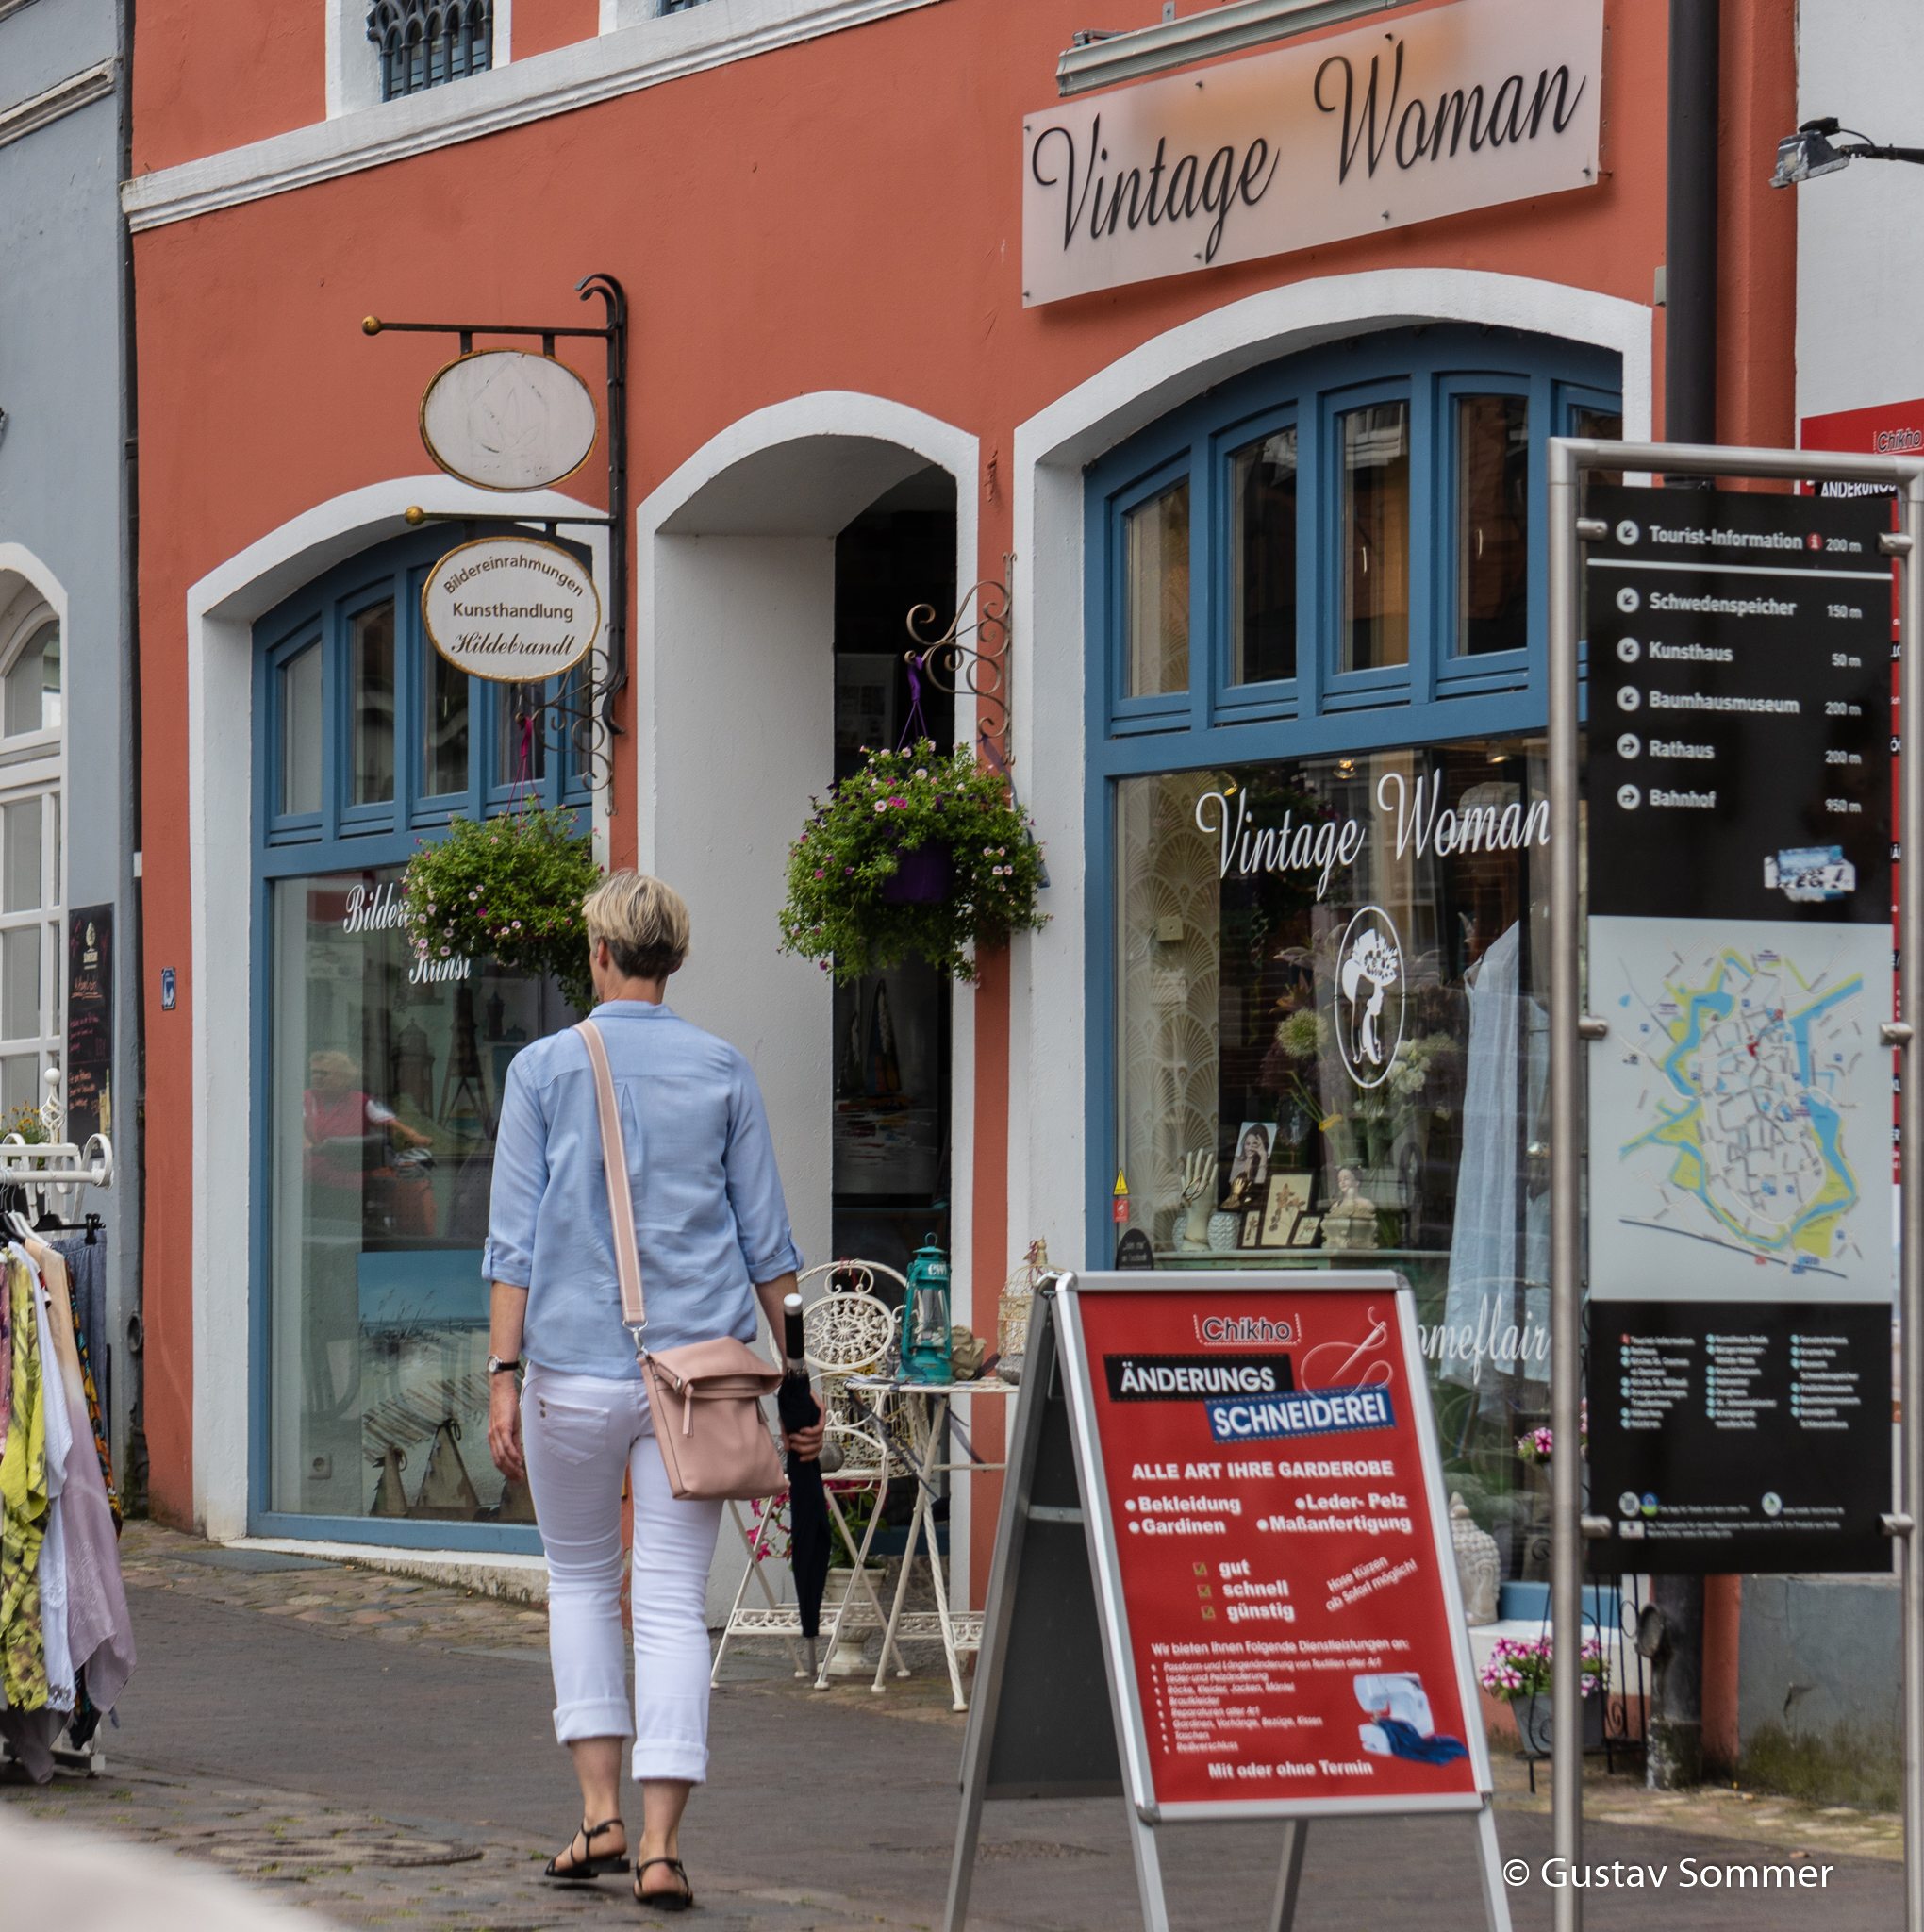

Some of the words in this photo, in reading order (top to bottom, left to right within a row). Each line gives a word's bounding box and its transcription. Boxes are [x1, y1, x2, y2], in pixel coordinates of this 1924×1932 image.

[1033, 112, 1280, 265] Vintage
[1314, 39, 1586, 186] Woman
[1877, 427, 1921, 453] Chikho
[1650, 525, 1802, 551] Tourist-Information
[1826, 538, 1847, 553] 200
[1849, 541, 1862, 553] m
[443, 554, 584, 597] Bildereinrahmungen
[453, 602, 573, 623] Kunsthandlung
[1650, 591, 1797, 617] Schwedenspeicher
[1827, 604, 1847, 618] 150
[1849, 608, 1862, 619] m
[451, 631, 575, 656] Hildebrandt
[1650, 641, 1733, 662] Kunsthaus
[1832, 654, 1847, 666] 50
[1849, 658, 1861, 667] m
[1650, 691, 1800, 713] Baumhausmuseum
[1825, 702, 1847, 715] 200
[1849, 706, 1862, 716] m
[1650, 740, 1715, 759] Rathaus
[1825, 750, 1847, 764] 200
[1849, 755, 1862, 765] m
[1650, 789, 1716, 808] Bahnhof
[1825, 799, 1847, 812] 950
[1849, 803, 1862, 813] m
[1195, 787, 1365, 901] Vintage
[1377, 768, 1549, 860] Woman
[1202, 1315, 1292, 1341] Chikho
[1120, 1361, 1276, 1393] ÄNDERUNGS
[1213, 1391, 1387, 1436] SCHNEIDEREI
[1132, 1463, 1179, 1479] ALLE
[1184, 1462, 1220, 1479] ART
[1228, 1461, 1275, 1478] IHRE
[1278, 1460, 1395, 1478] GARDEROBE
[1138, 1496, 1241, 1514] Bekleidung
[1368, 1492, 1407, 1509] Pelz
[1141, 1518, 1226, 1534] Gardinen
[1269, 1515, 1412, 1538] Maßanfertigung
[1219, 1559, 1250, 1579] gut
[1326, 1573, 1354, 1593] Hose
[1352, 1556, 1389, 1581] Kürzen
[1222, 1581, 1289, 1597] schnell
[1325, 1595, 1344, 1612] ab
[1341, 1579, 1373, 1605] Sofort
[1371, 1557, 1418, 1591] möglich!
[1226, 1602, 1296, 1623] günstig
[1152, 1642, 1169, 1657] Wir
[1171, 1641, 1209, 1656] bieten
[1211, 1641, 1243, 1655] Ihnen
[1245, 1640, 1296, 1656] Folgende
[1298, 1638, 1390, 1653] Dienstleistungen
[1295, 1659, 1310, 1670] von
[1311, 1657, 1345, 1669] Textilien
[1346, 1657, 1365, 1668] aller
[1367, 1657, 1382, 1668] Art
[1169, 1695, 1220, 1707] Brautkleider
[1170, 1707, 1224, 1720] Reparaturen
[1225, 1706, 1245, 1717] aller
[1246, 1705, 1261, 1717] Art
[1297, 1715, 1323, 1726] Kissen
[1174, 1729, 1210, 1740] Taschen
[1208, 1762, 1234, 1779] Mit
[1236, 1761, 1273, 1777] oder
[1275, 1760, 1317, 1776] ohne
[1319, 1759, 1374, 1775] Termin
